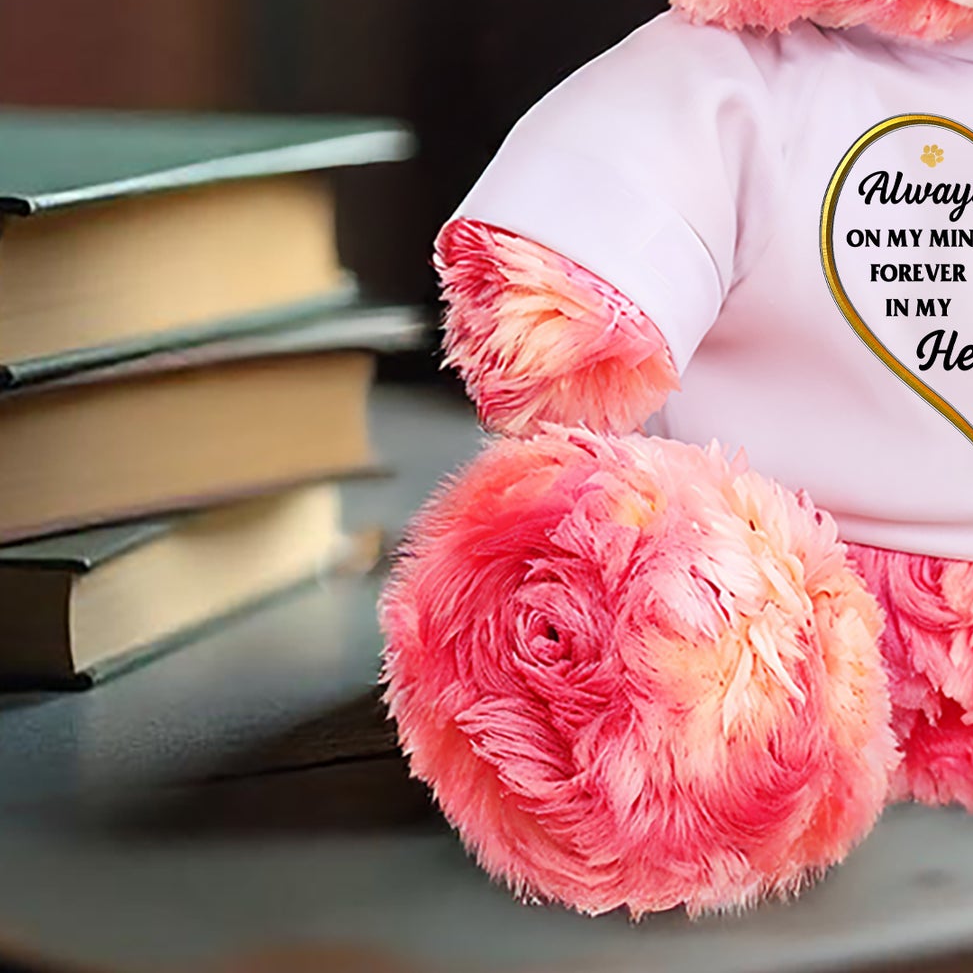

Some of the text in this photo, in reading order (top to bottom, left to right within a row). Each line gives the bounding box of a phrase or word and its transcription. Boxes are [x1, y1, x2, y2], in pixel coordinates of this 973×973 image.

[846, 228, 883, 248] ON
[887, 228, 923, 248] MY
[870, 263, 967, 283] FOREVER
[885, 298, 952, 317] IN MY
